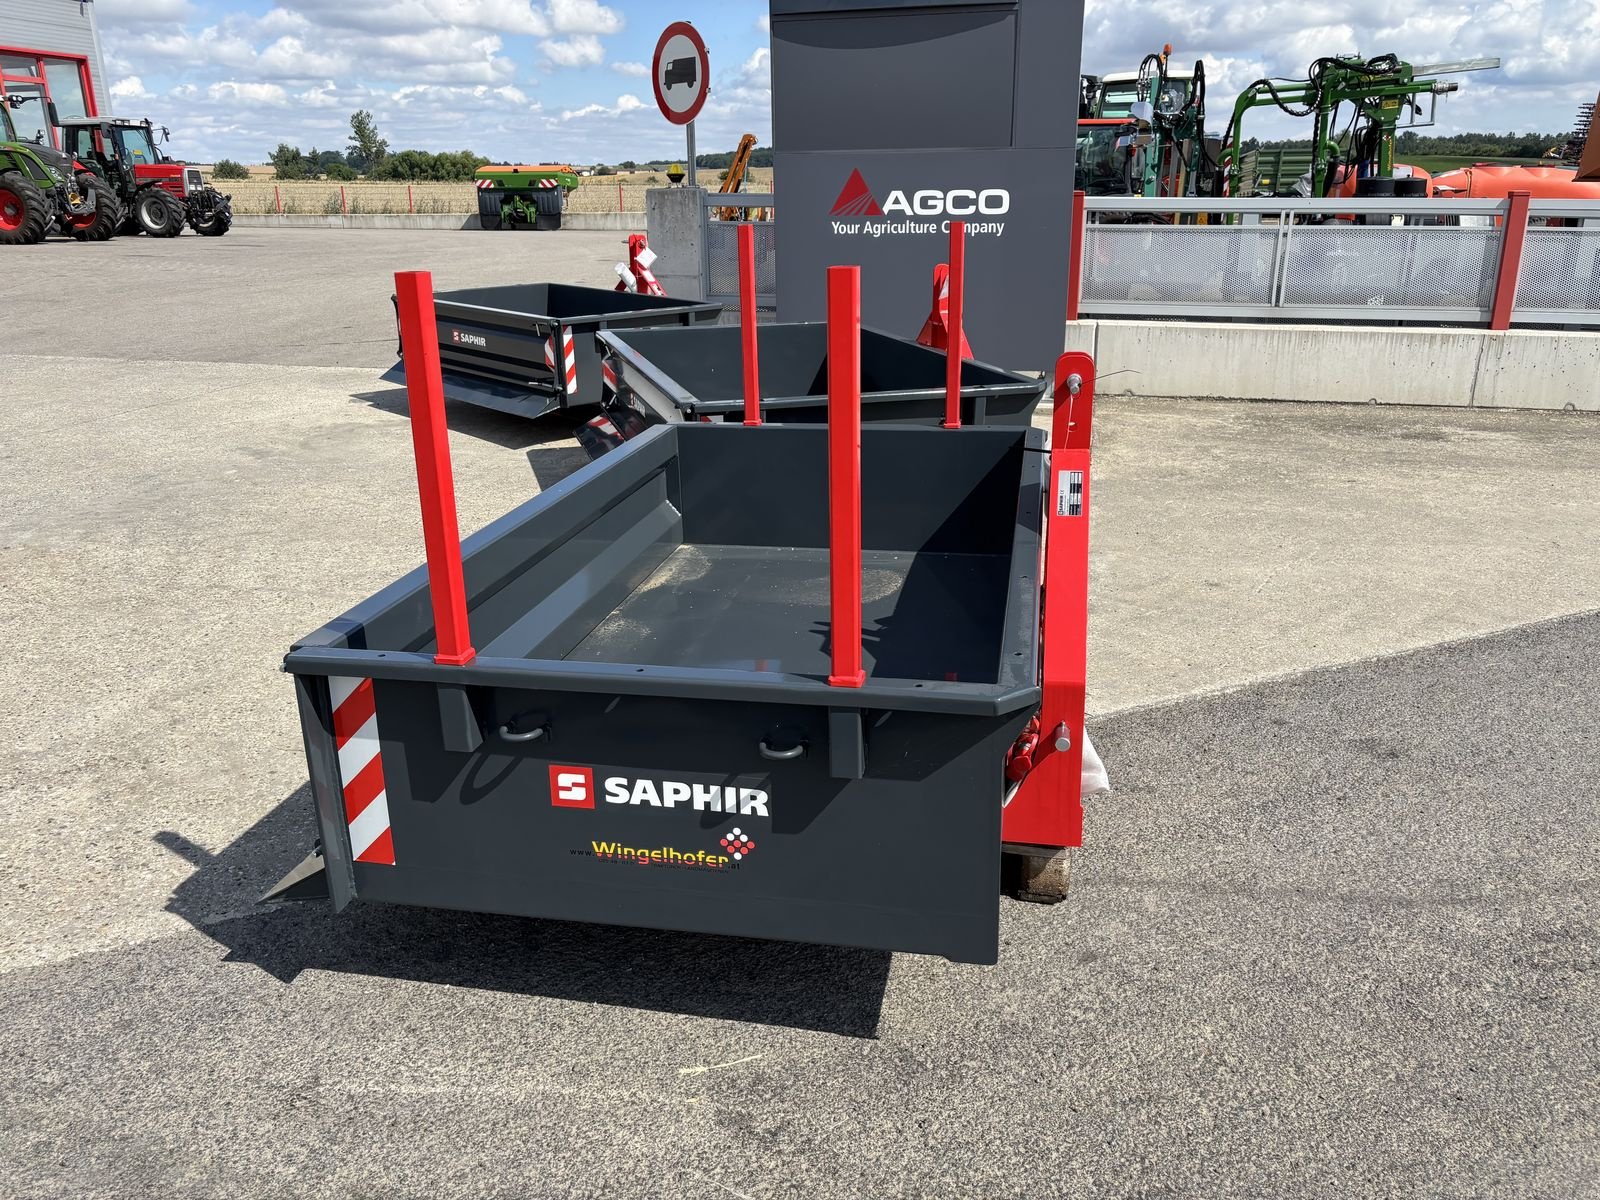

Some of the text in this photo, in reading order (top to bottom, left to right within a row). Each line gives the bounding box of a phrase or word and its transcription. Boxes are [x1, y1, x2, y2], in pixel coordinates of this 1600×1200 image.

[882, 189, 1010, 216] AGCO
[831, 221, 860, 235] Your
[863, 220, 937, 238] Agriculture
[460, 333, 486, 347] SAPHIR
[604, 776, 769, 817] SAPHIR
